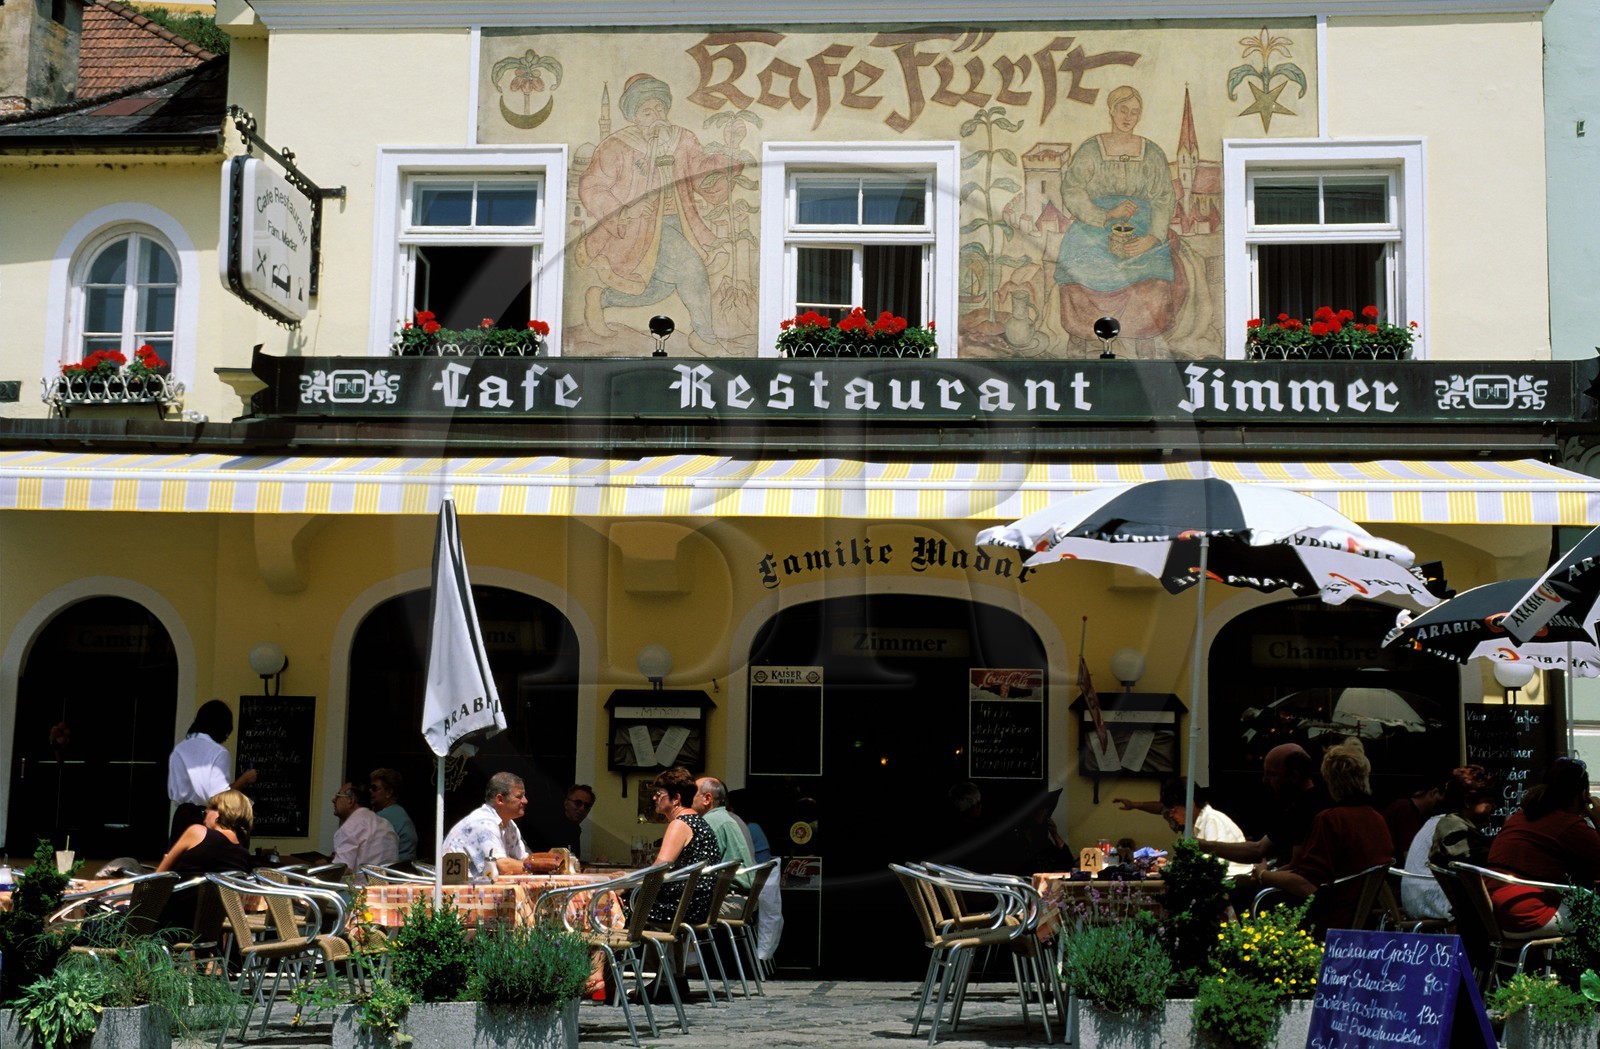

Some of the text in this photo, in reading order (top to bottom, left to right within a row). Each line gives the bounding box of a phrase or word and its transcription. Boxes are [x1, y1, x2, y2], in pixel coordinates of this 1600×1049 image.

[257, 187, 308, 246] Cafe Restaurant
[432, 362, 1401, 413] Cafe Restaurant Zimmer
[758, 536, 1037, 589] Familie Madar
[1510, 592, 1547, 628] ARABIA
[1416, 619, 1482, 641] ARABIA
[853, 632, 947, 651] Zimmer
[1268, 640, 1378, 660] Chambre
[771, 670, 802, 680] KAISER
[446, 858, 461, 875] 25
[1084, 853, 1097, 867] 21
